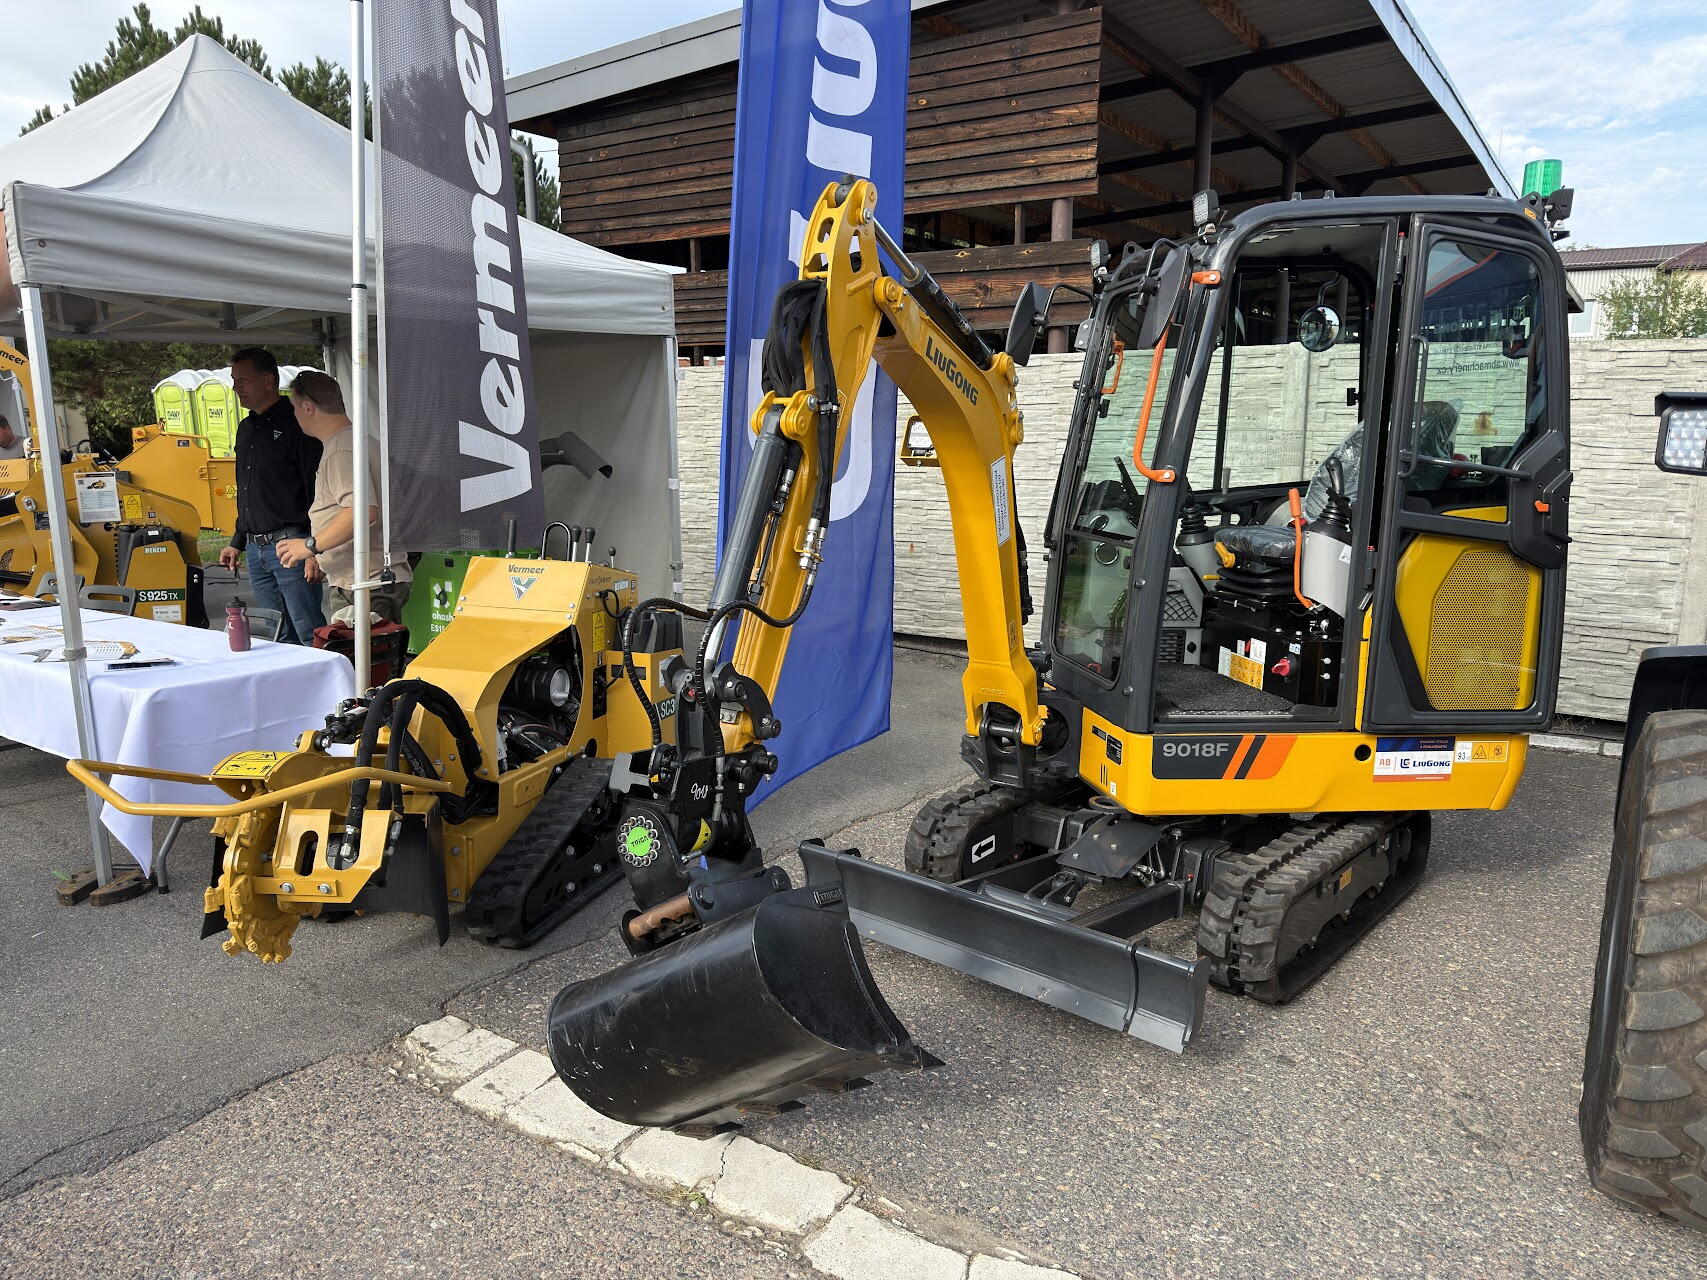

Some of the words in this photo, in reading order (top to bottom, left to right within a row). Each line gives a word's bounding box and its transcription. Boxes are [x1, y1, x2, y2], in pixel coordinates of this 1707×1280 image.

[449, 0, 533, 512] Vermeer
[508, 564, 545, 574] Vermeer
[1162, 742, 1229, 757] 9018F
